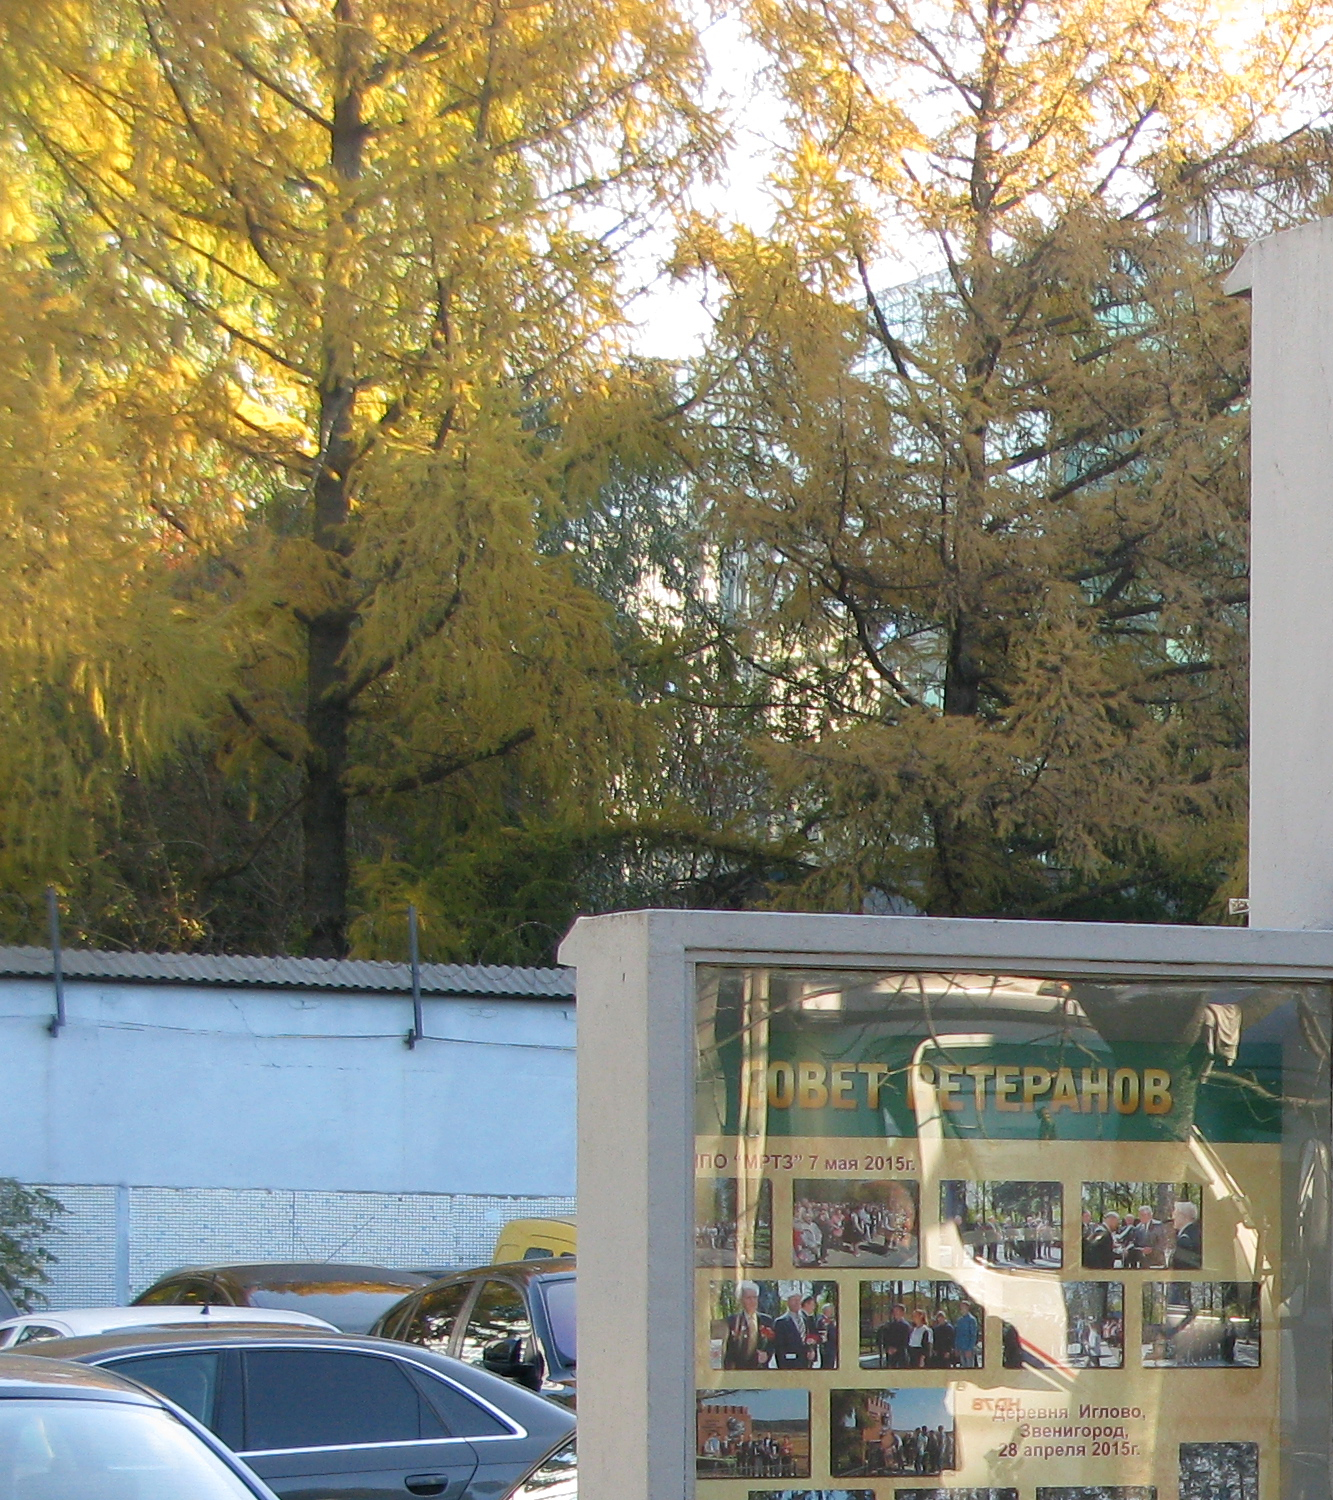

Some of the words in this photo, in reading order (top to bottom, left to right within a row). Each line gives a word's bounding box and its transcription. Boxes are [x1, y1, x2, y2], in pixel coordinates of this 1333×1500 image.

[695, 1154, 728, 1170] ПО
[808, 1155, 818, 1170] 7
[825, 1158, 858, 1171] мая
[864, 1155, 916, 1171] 2015г.
[992, 1404, 1068, 1422] Деревня
[1079, 1404, 1146, 1421] Иглово,
[1020, 1423, 1129, 1440] Звенигород,
[998, 1442, 1018, 1457] 28
[1024, 1445, 1086, 1460] апреля
[1092, 1442, 1141, 1457] 2015г.
